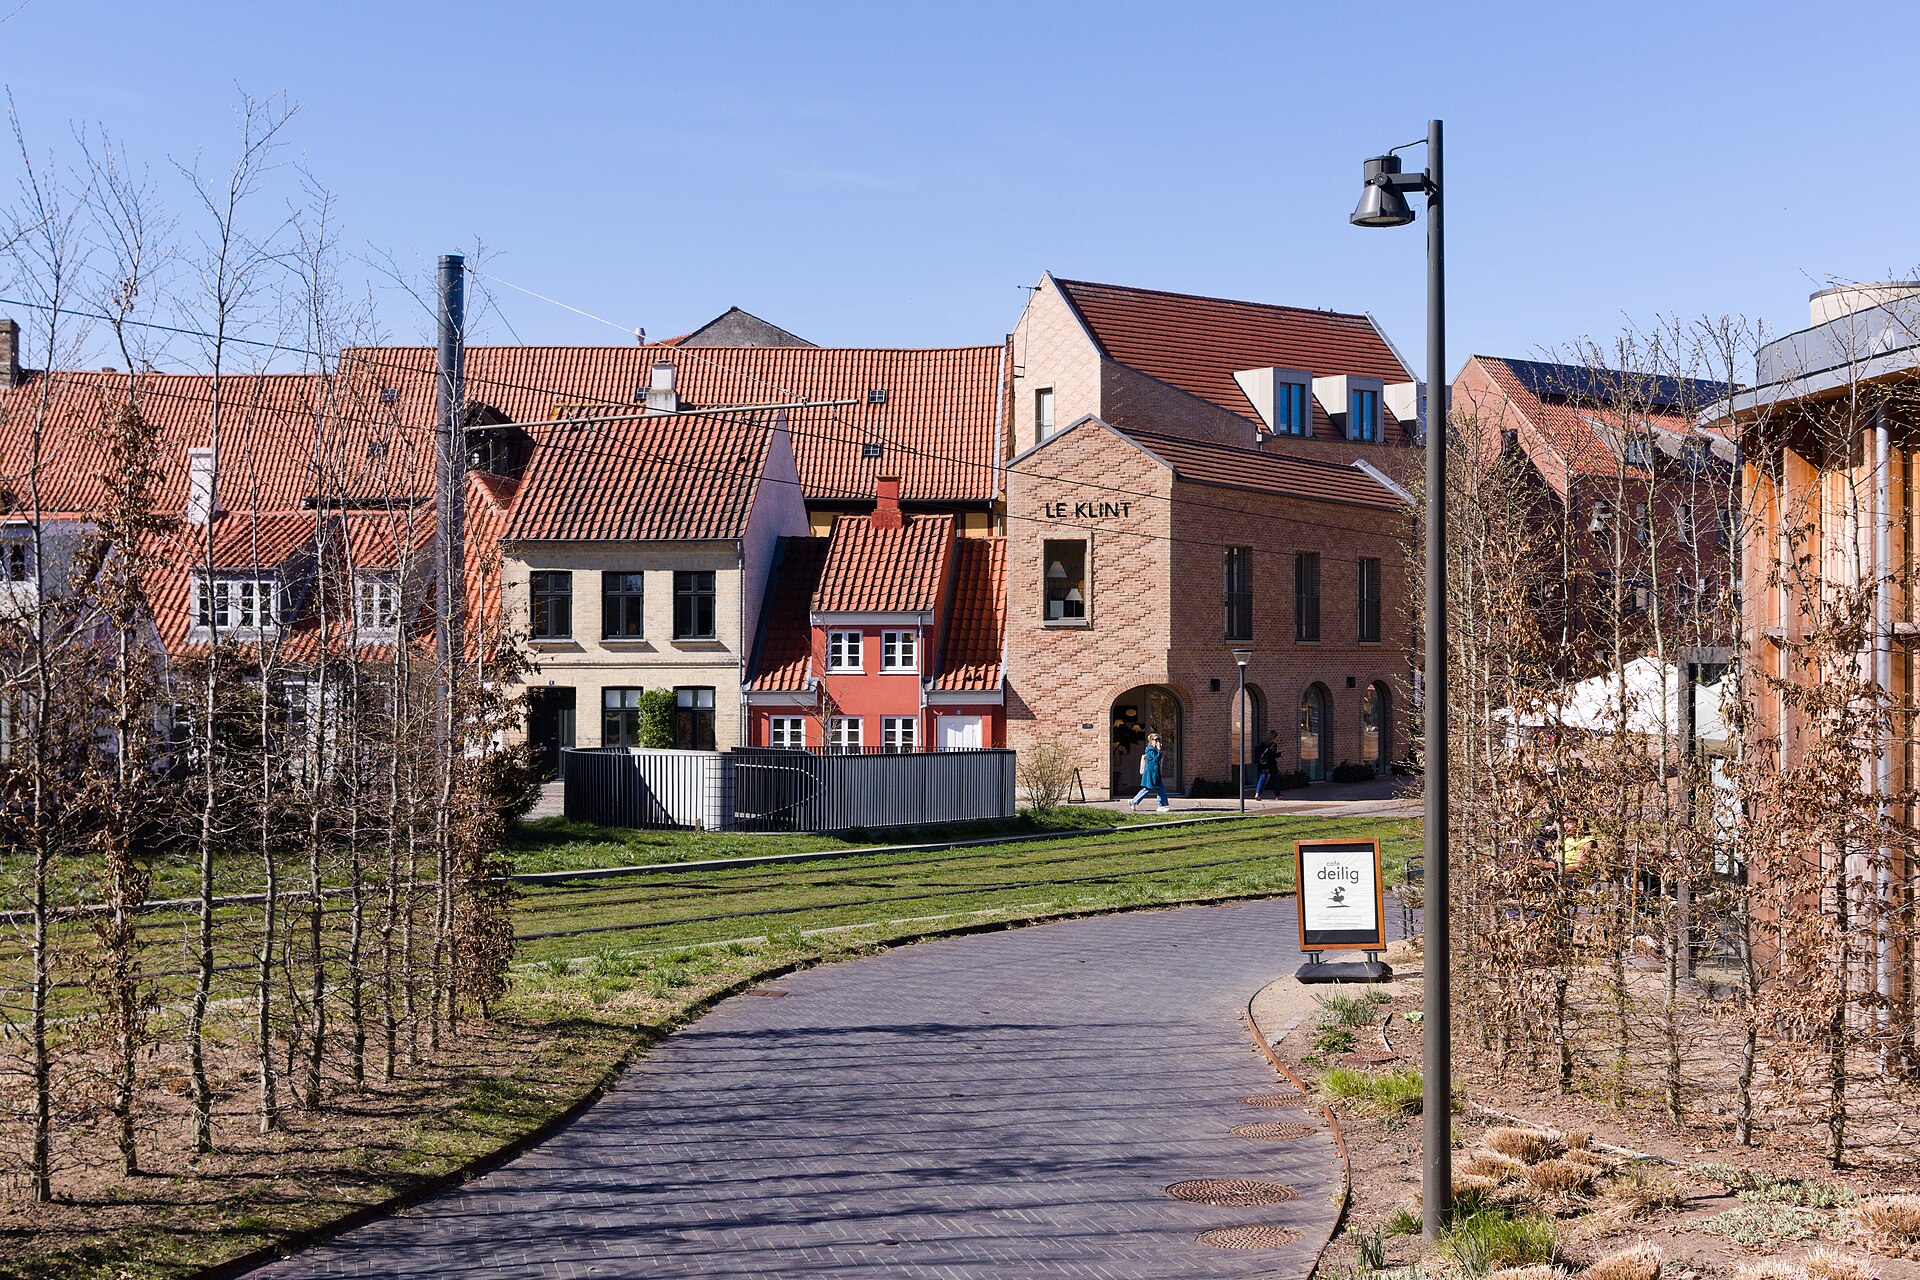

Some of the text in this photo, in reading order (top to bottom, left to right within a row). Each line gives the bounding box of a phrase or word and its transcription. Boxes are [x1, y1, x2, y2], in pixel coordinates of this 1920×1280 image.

[1045, 502, 1132, 518] LE KLINT
[1317, 866, 1359, 884] deilig
